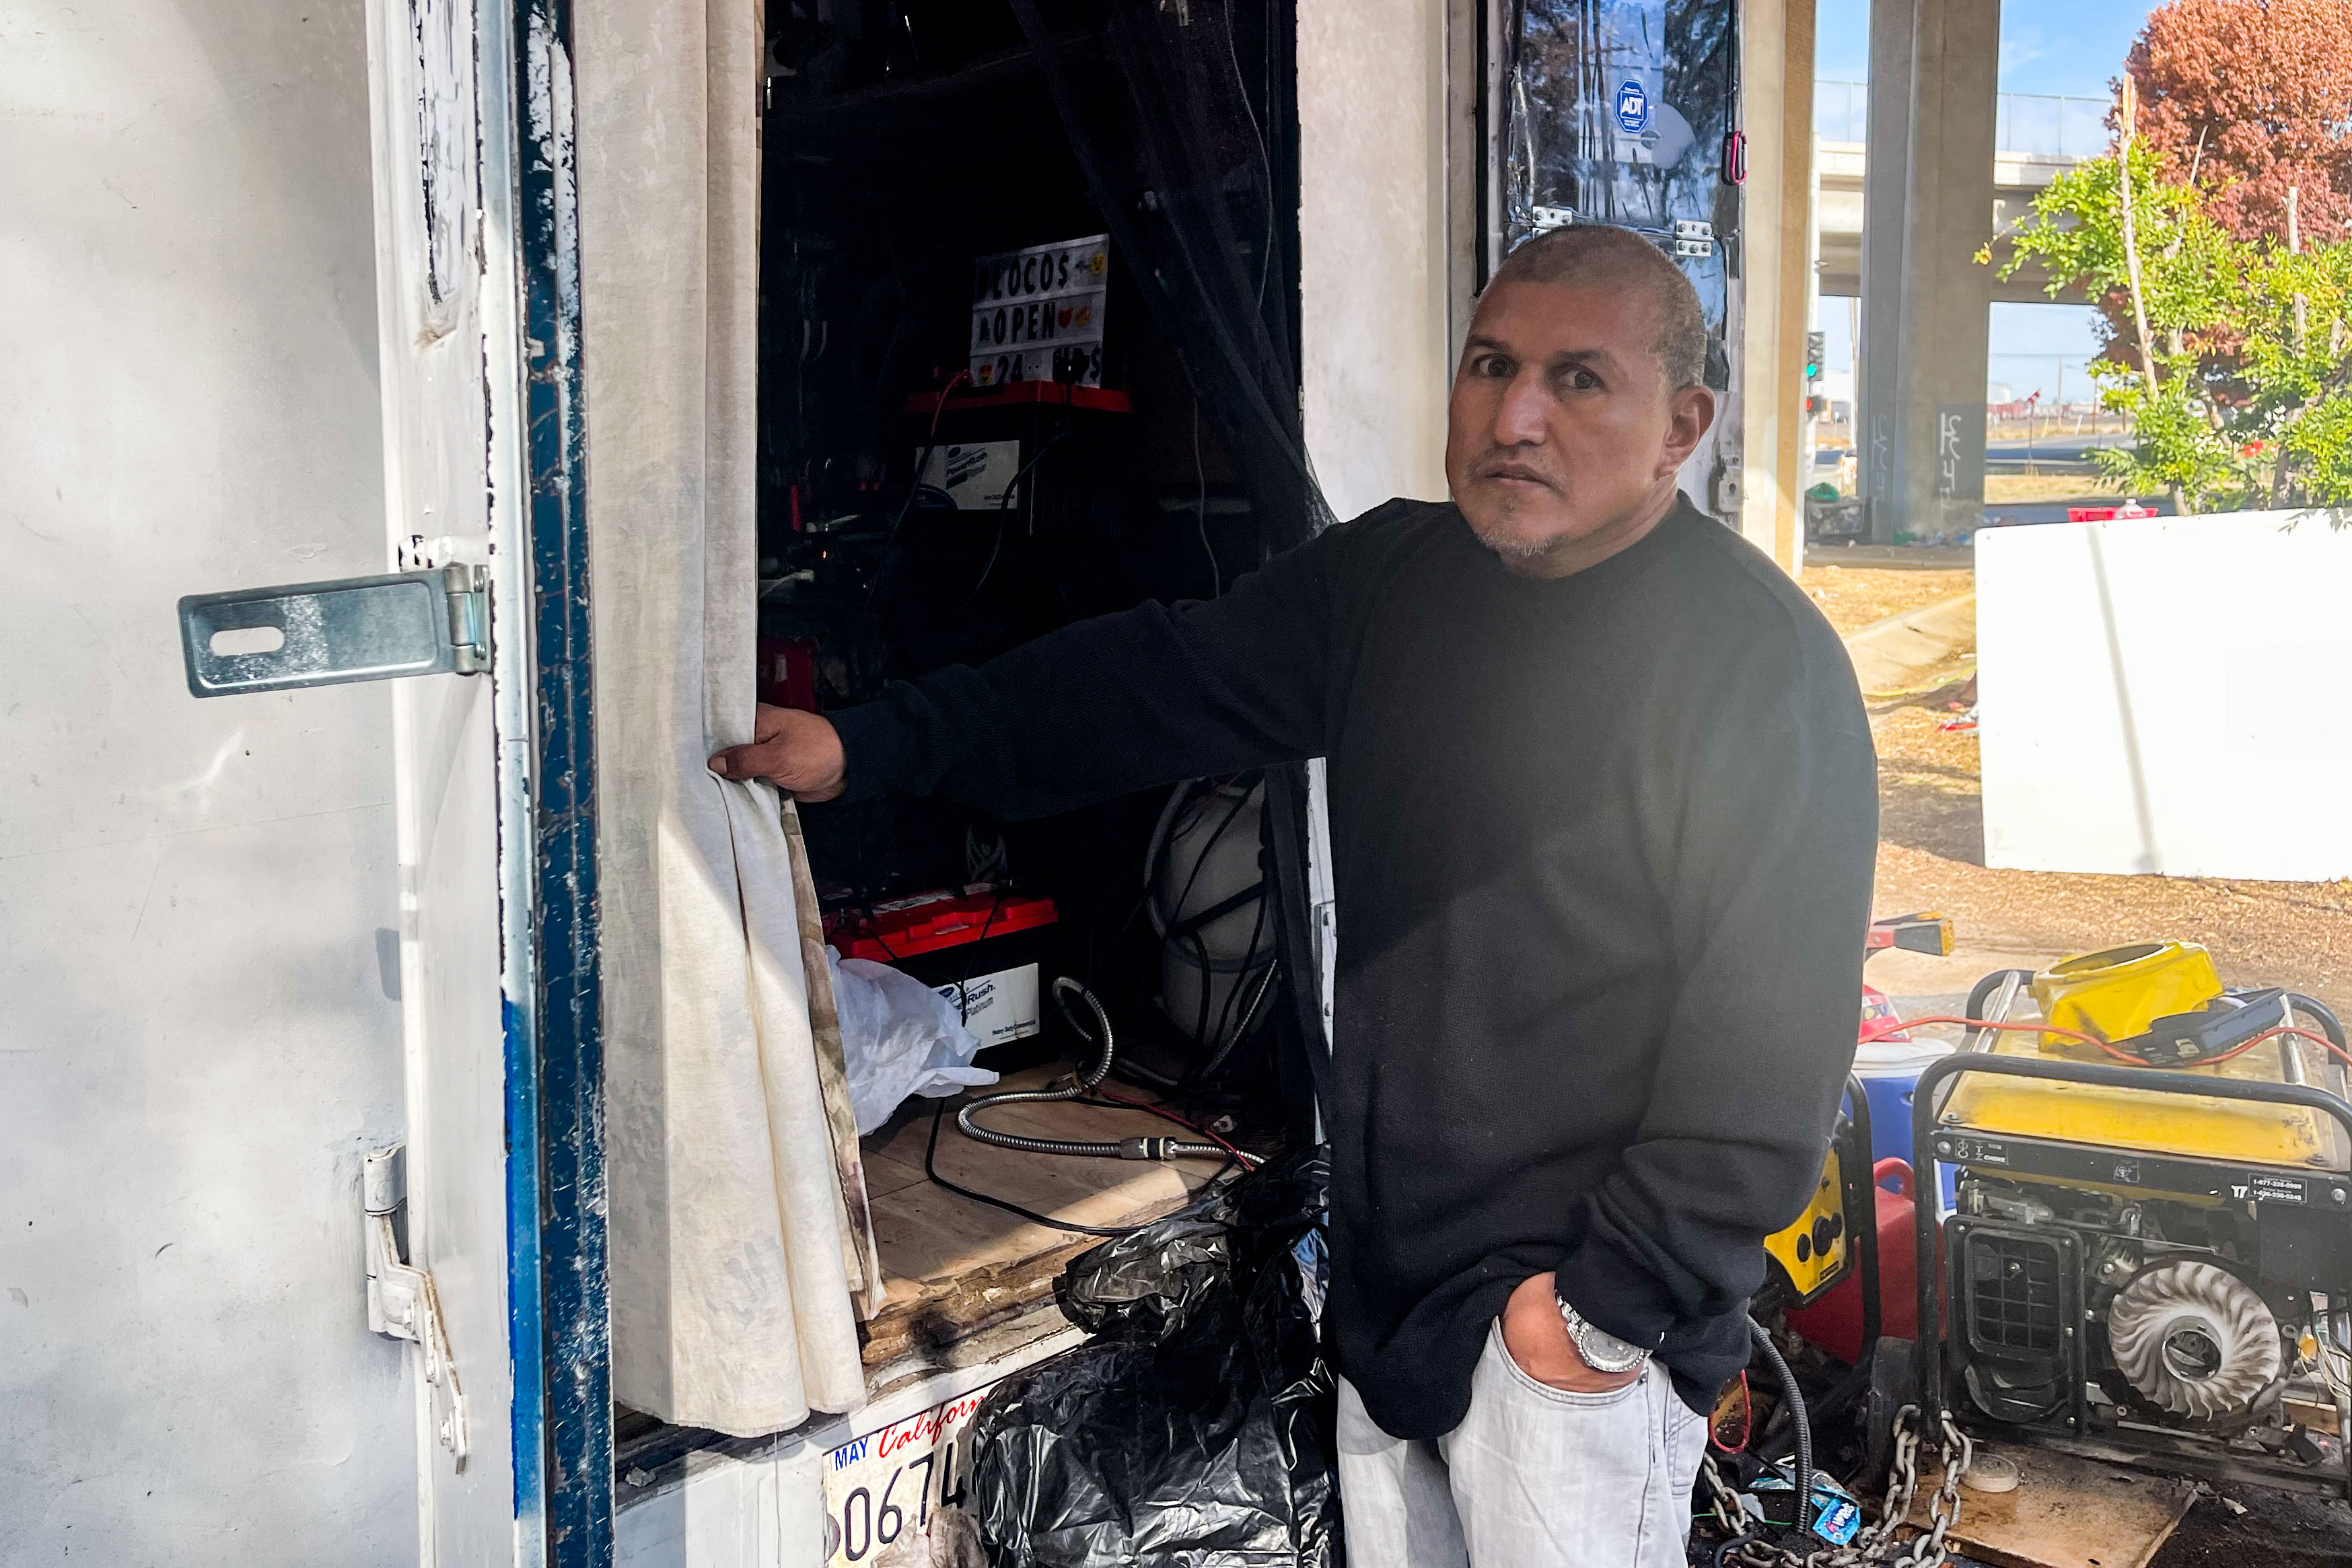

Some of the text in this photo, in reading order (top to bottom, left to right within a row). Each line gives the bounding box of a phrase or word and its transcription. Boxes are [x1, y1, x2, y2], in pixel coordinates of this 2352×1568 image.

[1620, 96, 1643, 115] ADT
[994, 302, 1056, 345] OPEN
[997, 354, 1024, 382] 24
[834, 1437, 869, 1472] MAY
[844, 1439, 976, 1561] 0674
